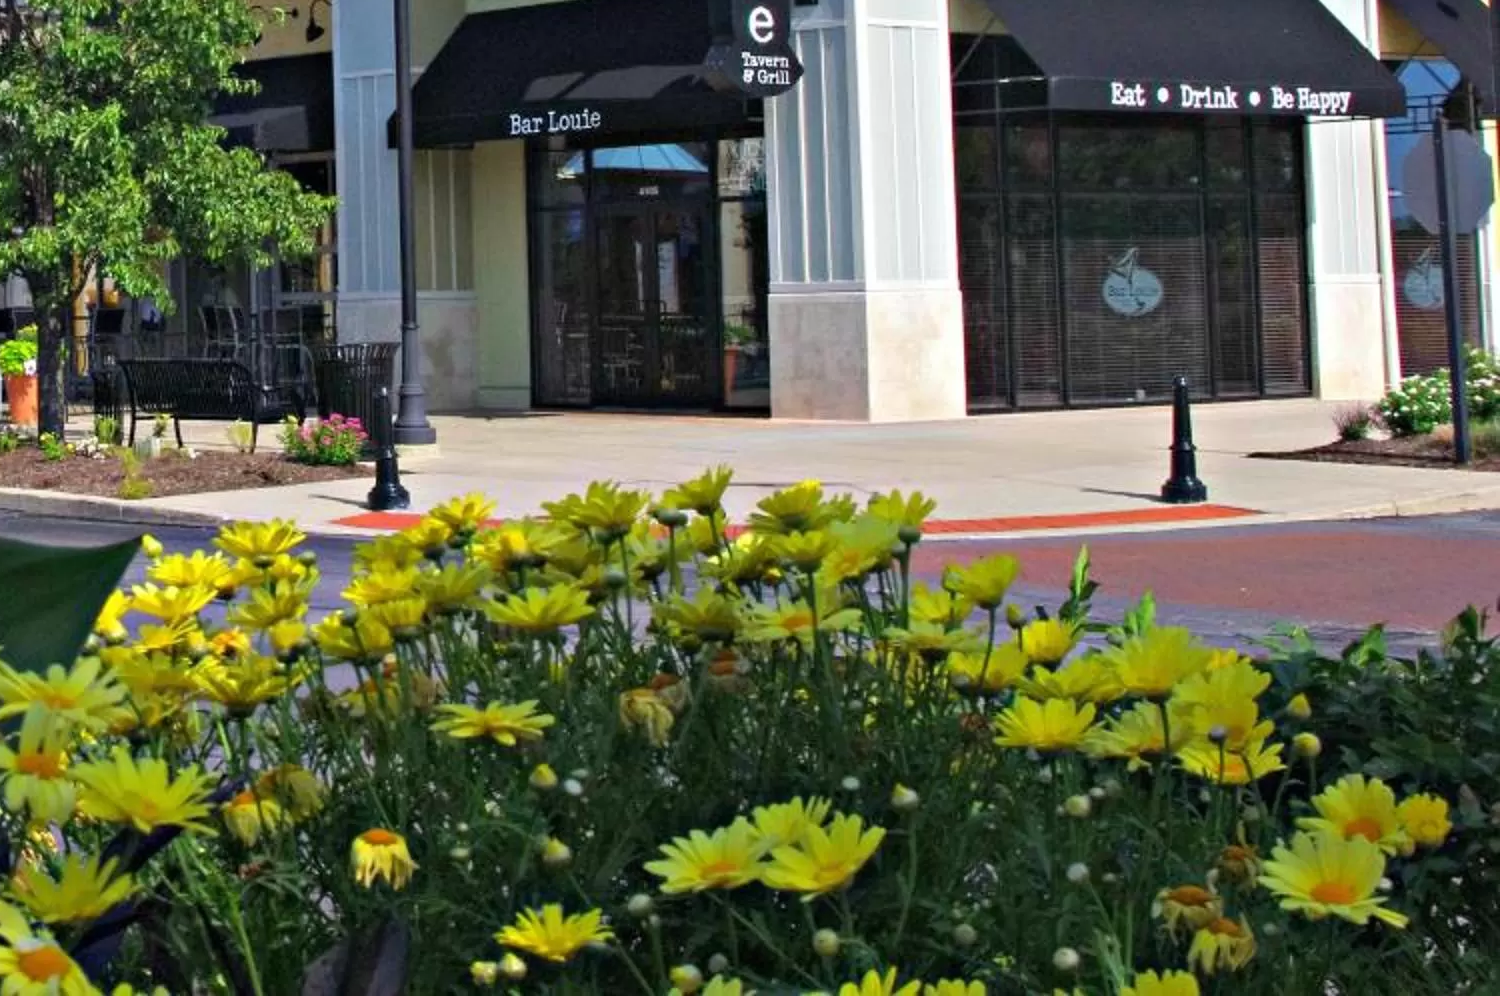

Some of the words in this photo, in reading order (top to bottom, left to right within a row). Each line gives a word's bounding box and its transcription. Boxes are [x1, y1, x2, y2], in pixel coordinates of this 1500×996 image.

[741, 51, 789, 69] Tavern
[757, 69, 791, 85] Grill
[1111, 82, 1146, 106] Eat
[1180, 84, 1238, 109] Drink
[1271, 86, 1294, 110] Be
[1296, 87, 1351, 114] Happy
[509, 113, 543, 135] Bar
[547, 108, 601, 133] Louie
